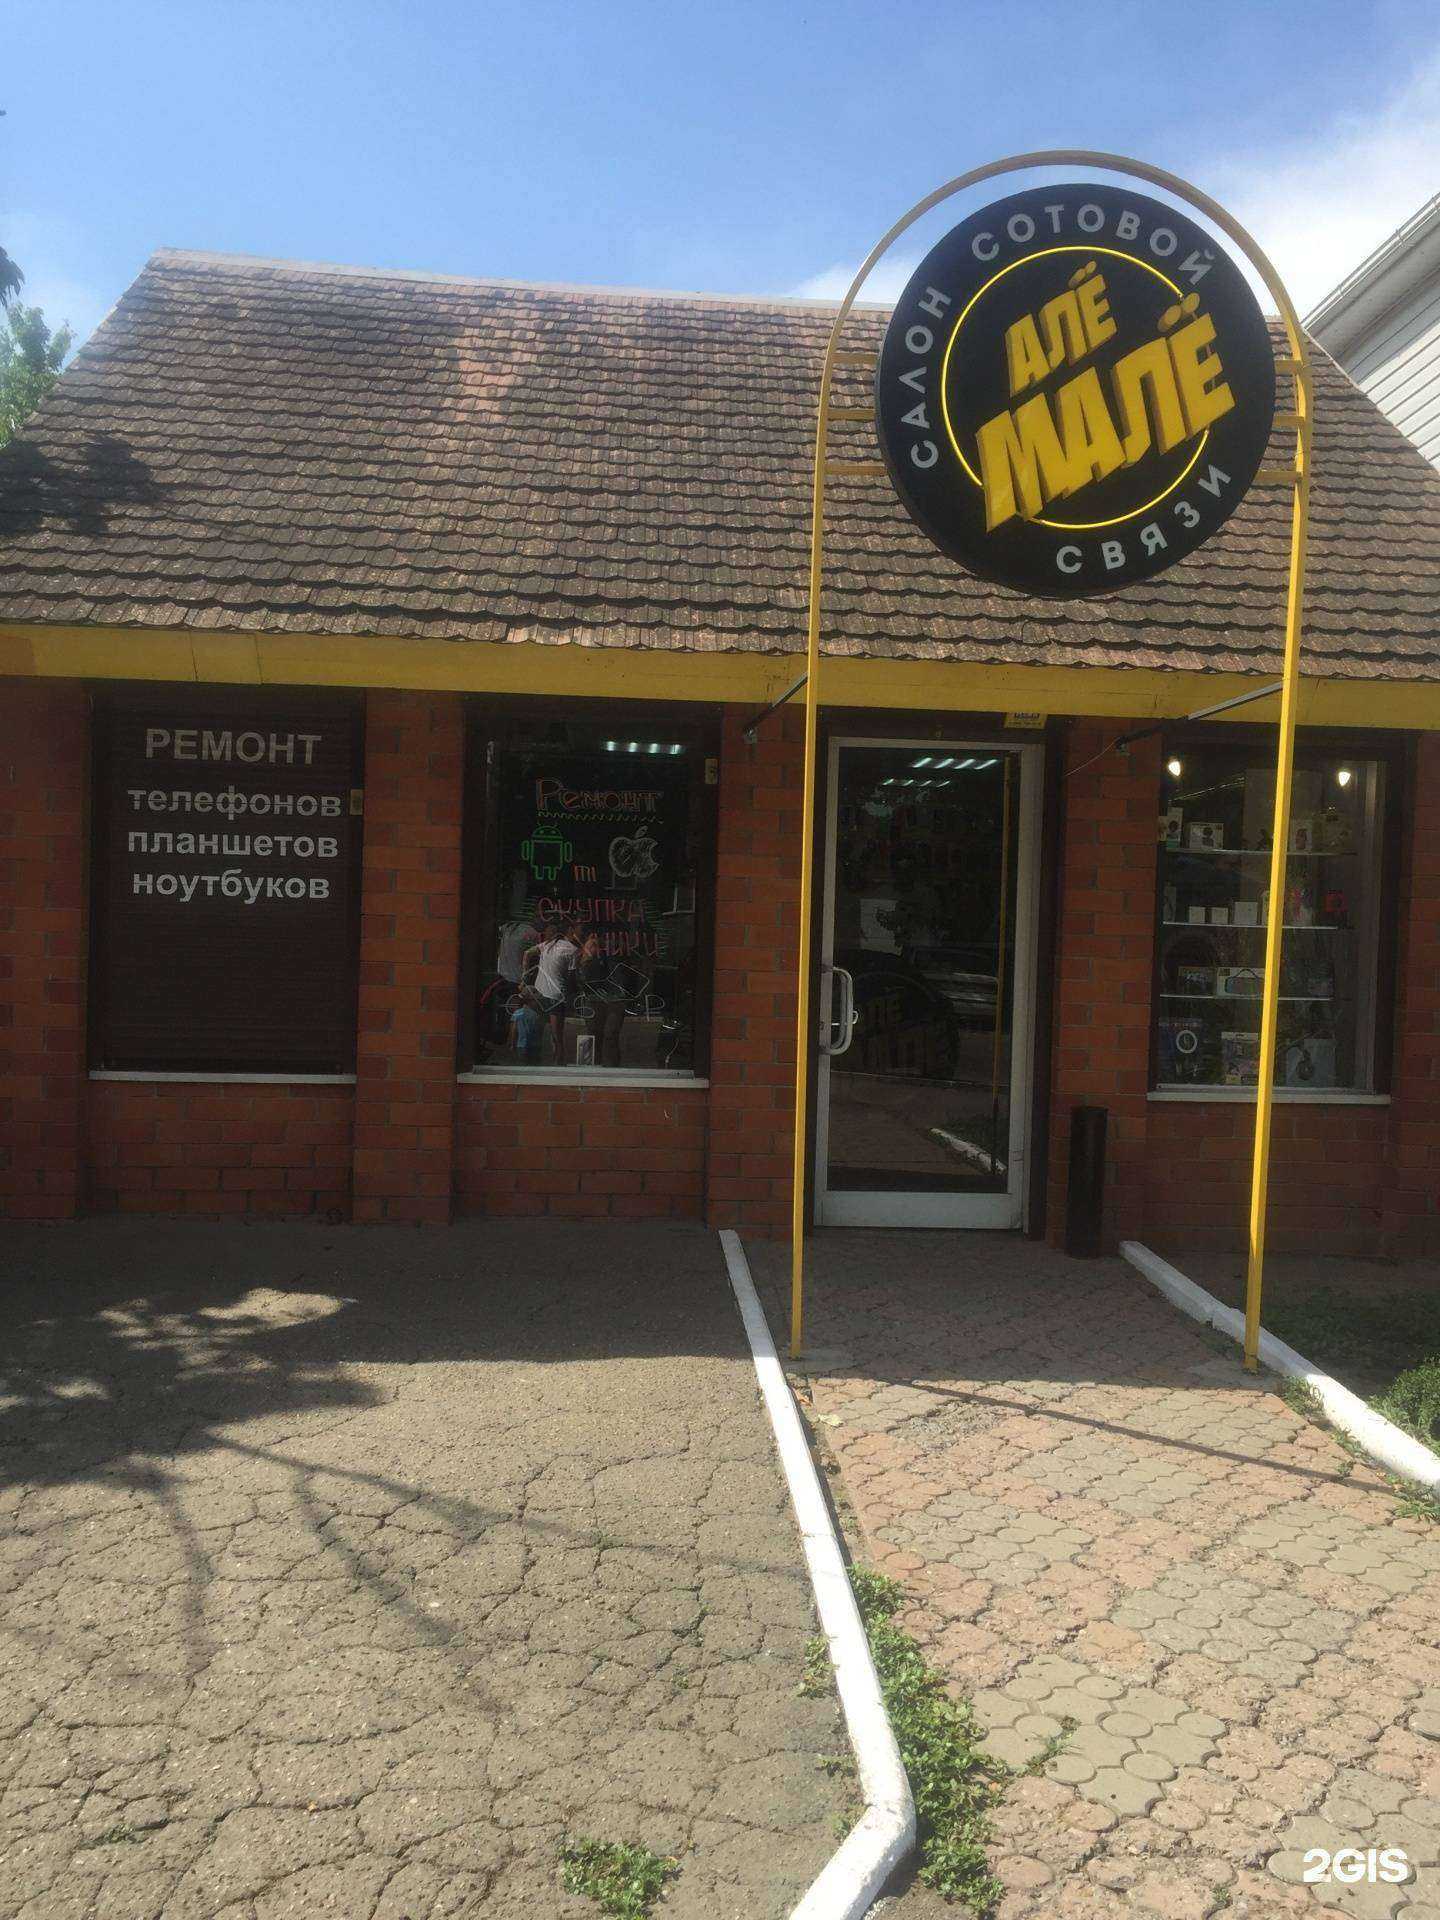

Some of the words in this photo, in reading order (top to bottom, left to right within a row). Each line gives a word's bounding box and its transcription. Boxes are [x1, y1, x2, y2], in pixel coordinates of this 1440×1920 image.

[898, 285, 952, 469] САЛОН
[971, 203, 1215, 286] СОТОВОЙ
[1004, 260, 1118, 398] АЛЁ
[975, 292, 1236, 533] МАЛЁ
[1056, 464, 1231, 574] СВЯЗИ
[145, 728, 322, 764] РЕМОНТ
[127, 785, 342, 820] телефонов
[127, 831, 339, 857] планшетов
[132, 868, 330, 904] ноутбуков
